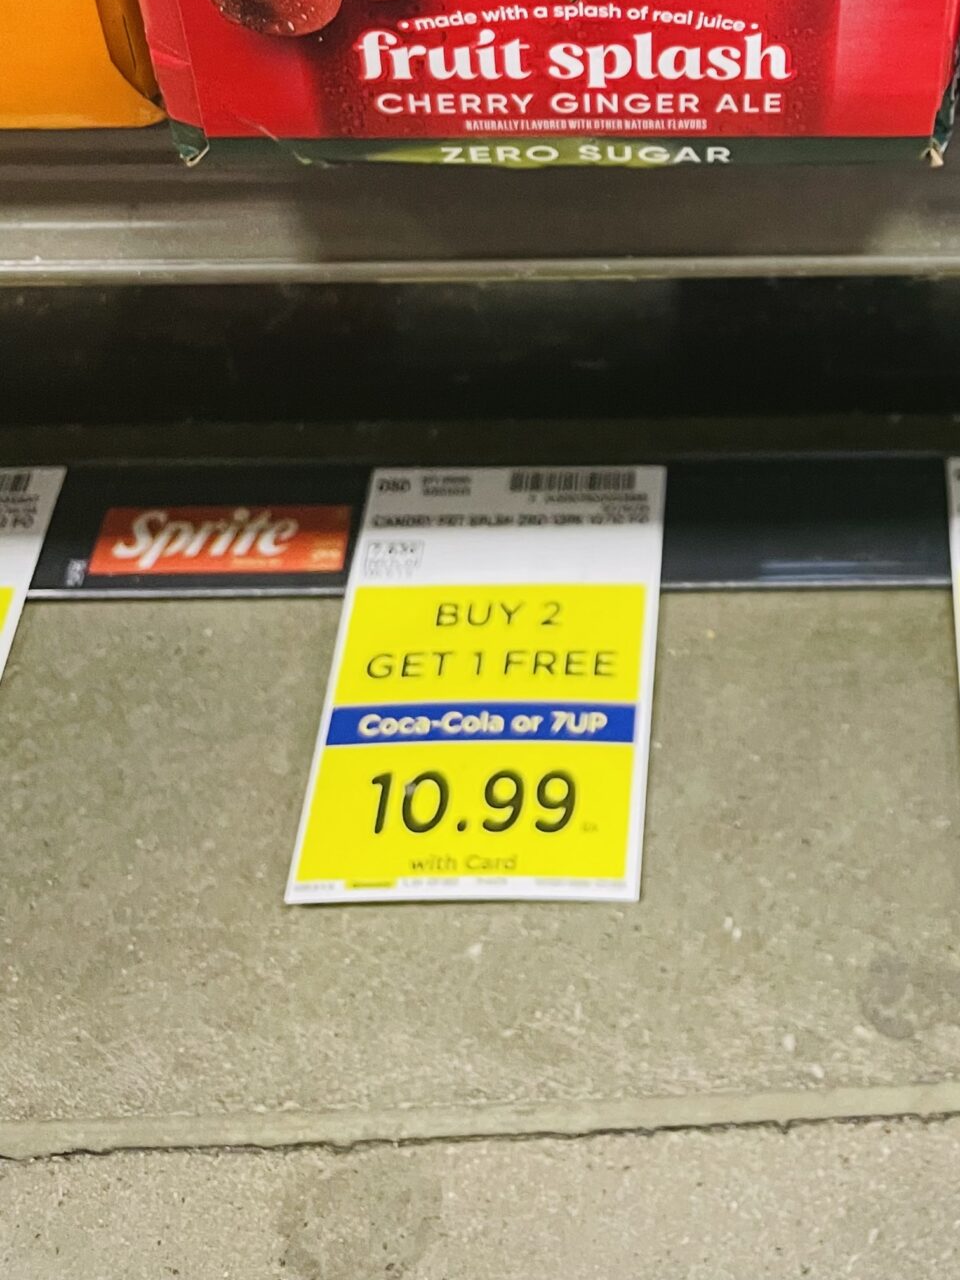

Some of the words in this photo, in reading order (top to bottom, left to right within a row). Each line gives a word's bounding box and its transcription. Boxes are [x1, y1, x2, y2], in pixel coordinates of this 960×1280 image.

[415, 12, 477, 30] made
[482, 6, 528, 21] with
[533, 6, 548, 18] a
[553, 3, 622, 21] splash
[626, 6, 648, 20] of
[652, 10, 693, 25] real
[695, 11, 746, 32] juice
[357, 29, 533, 80] fruit
[548, 34, 792, 88] splash
[375, 92, 533, 114] CHERRY
[550, 93, 700, 114] GINGER
[715, 93, 783, 113] ALE
[440, 145, 559, 163] ZERO
[578, 144, 731, 163] SUGAR
[111, 506, 299, 569] Sprite
[435, 602, 524, 627] BUY
[541, 601, 563, 626] 2
[366, 651, 453, 679] GET
[473, 651, 483, 676] 1
[504, 650, 619, 677] FREE
[357, 710, 505, 737] Coca-Cola
[511, 716, 542, 735] or
[550, 711, 609, 734] 7UP
[371, 769, 577, 834] 10.99
[409, 856, 457, 871] with
[465, 855, 518, 871] Card
